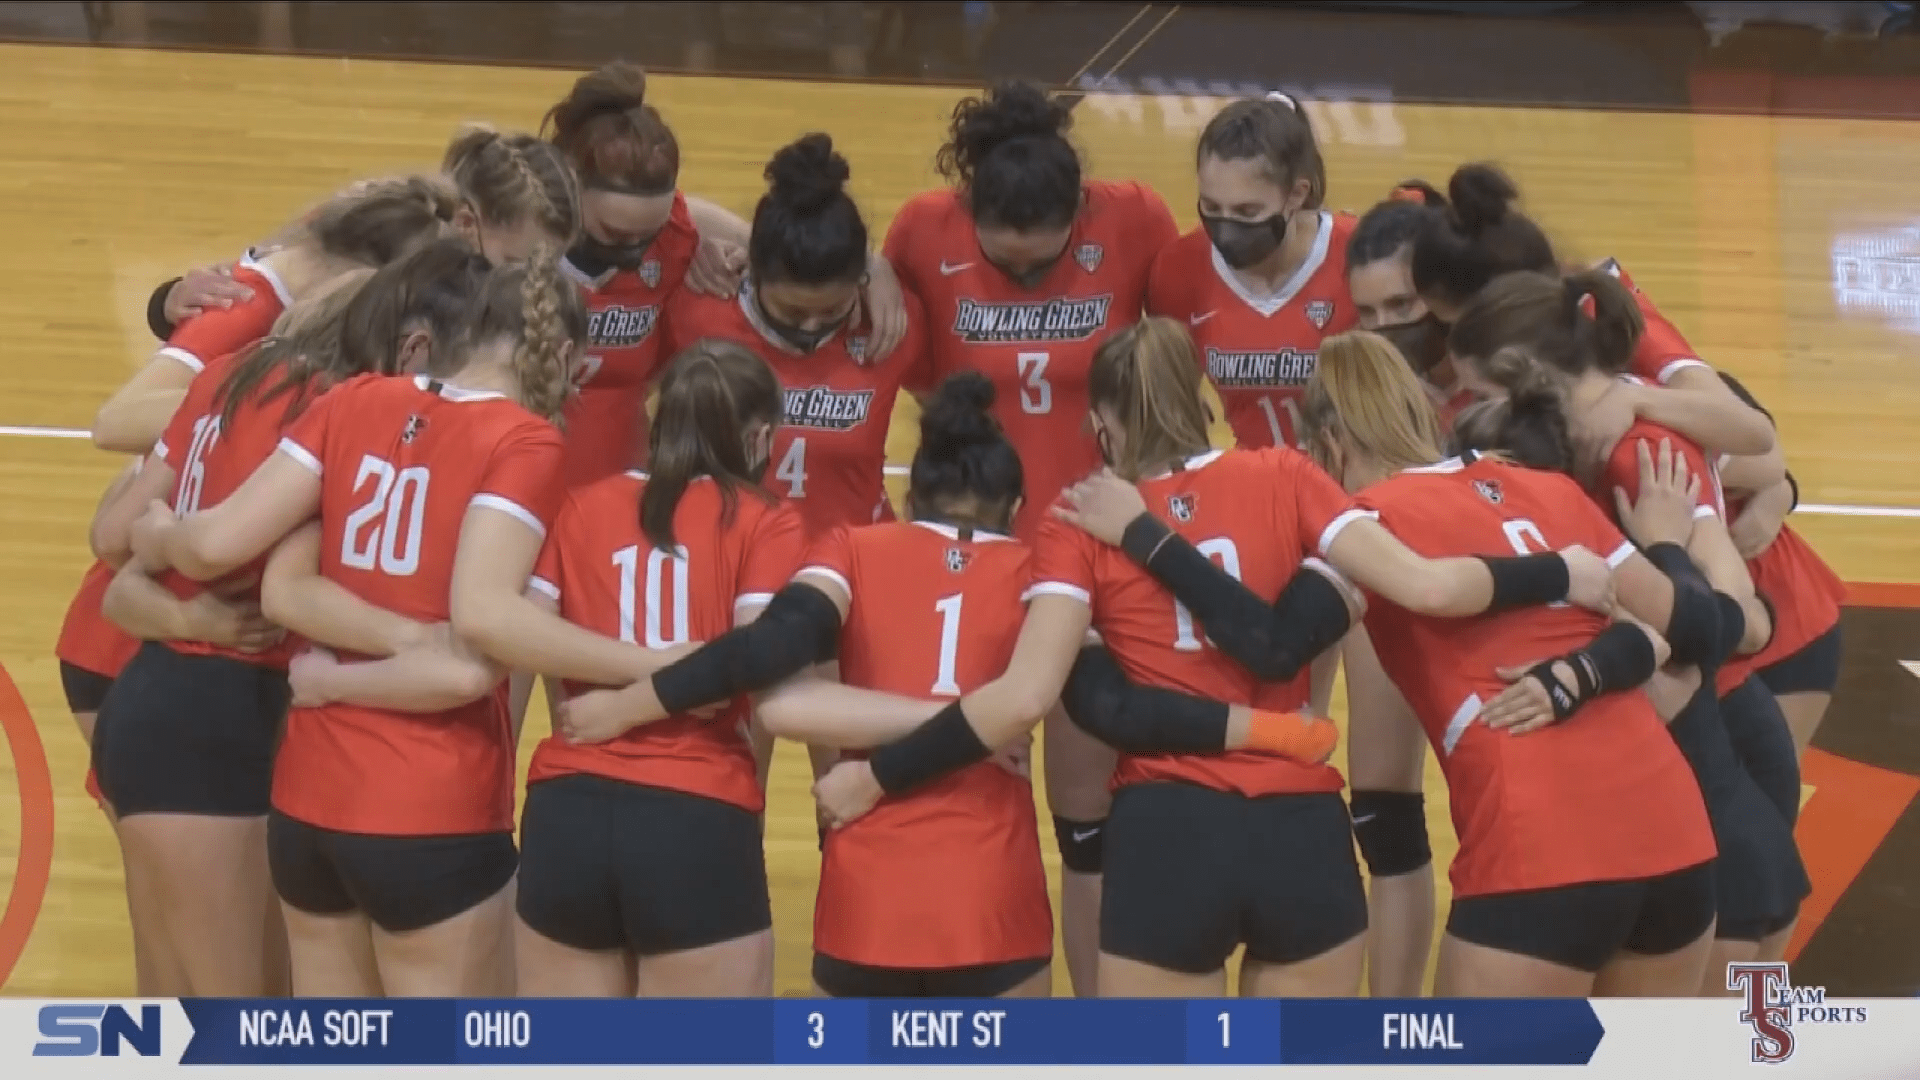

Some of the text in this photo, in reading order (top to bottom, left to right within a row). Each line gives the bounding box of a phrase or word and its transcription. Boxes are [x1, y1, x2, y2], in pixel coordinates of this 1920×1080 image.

[957, 300, 1109, 331] BOWLING GREEN
[1017, 353, 1053, 414] 3
[1207, 350, 1277, 379] BOWLING
[806, 389, 870, 420] GREEN
[775, 437, 808, 498] 4
[341, 454, 430, 576] 20
[611, 545, 689, 650] 10
[931, 593, 963, 696] 1
